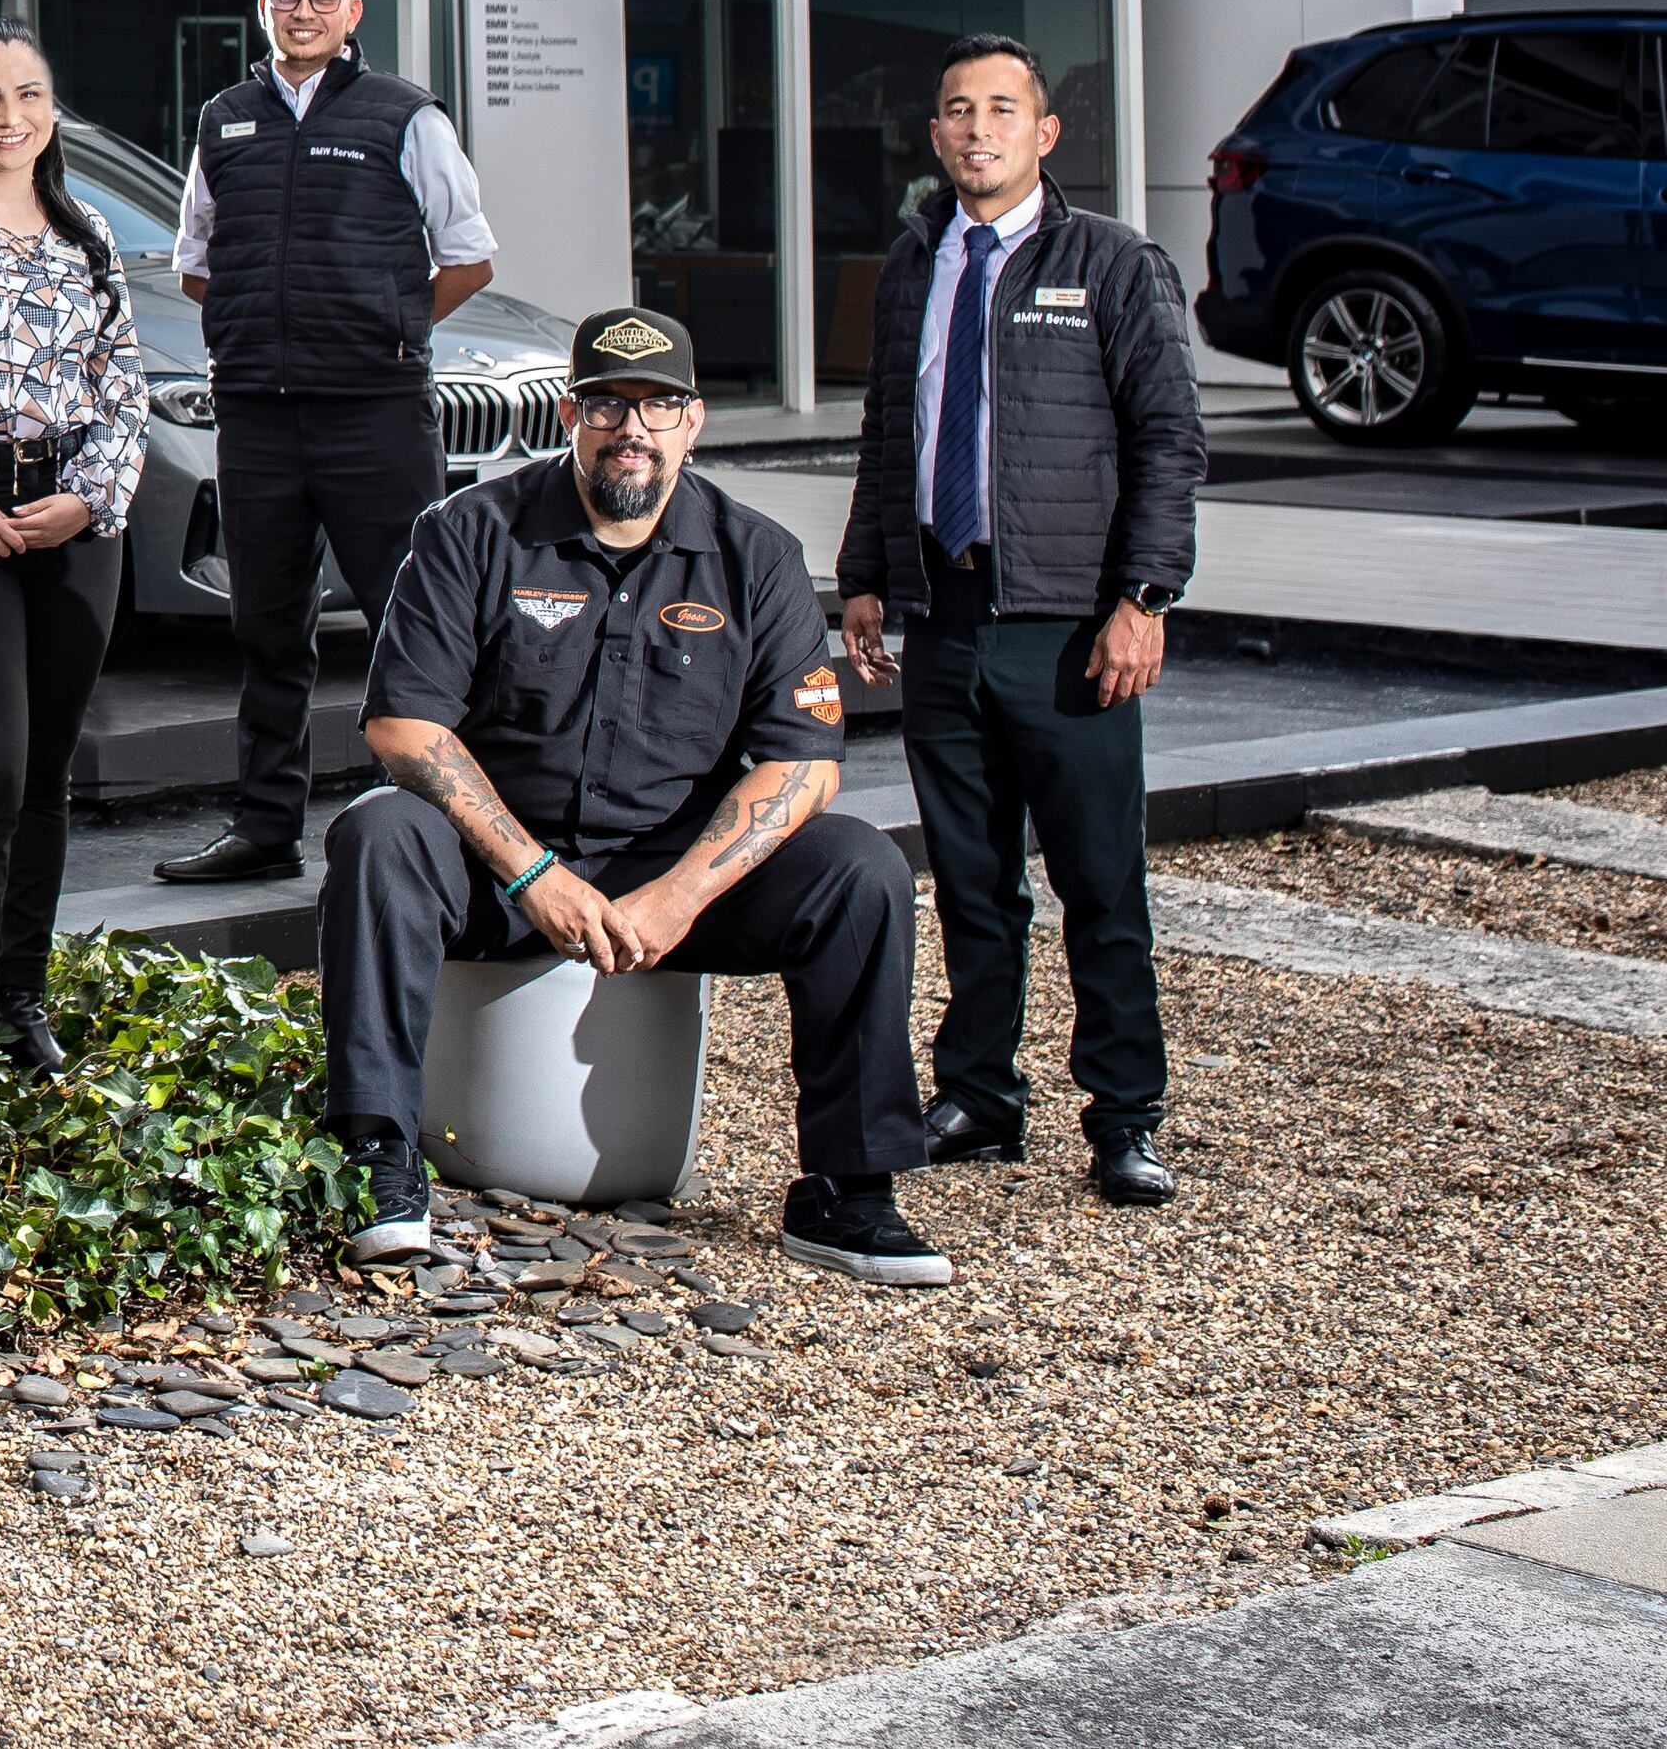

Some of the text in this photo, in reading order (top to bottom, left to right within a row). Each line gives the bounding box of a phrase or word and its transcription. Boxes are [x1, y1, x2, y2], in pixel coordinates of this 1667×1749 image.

[485, 4, 509, 15] BMW
[485, 19, 509, 30] BMW
[485, 34, 509, 45] BMW
[486, 50, 509, 61] BMW
[486, 65, 510, 76] BMW
[487, 81, 510, 92] BMW
[487, 96, 511, 107] BMW
[310, 147, 366, 161] BMW Service
[1013, 311, 1089, 328] BMW Service
[602, 336, 664, 349] DAVIDSON
[677, 608, 708, 623] Goose
